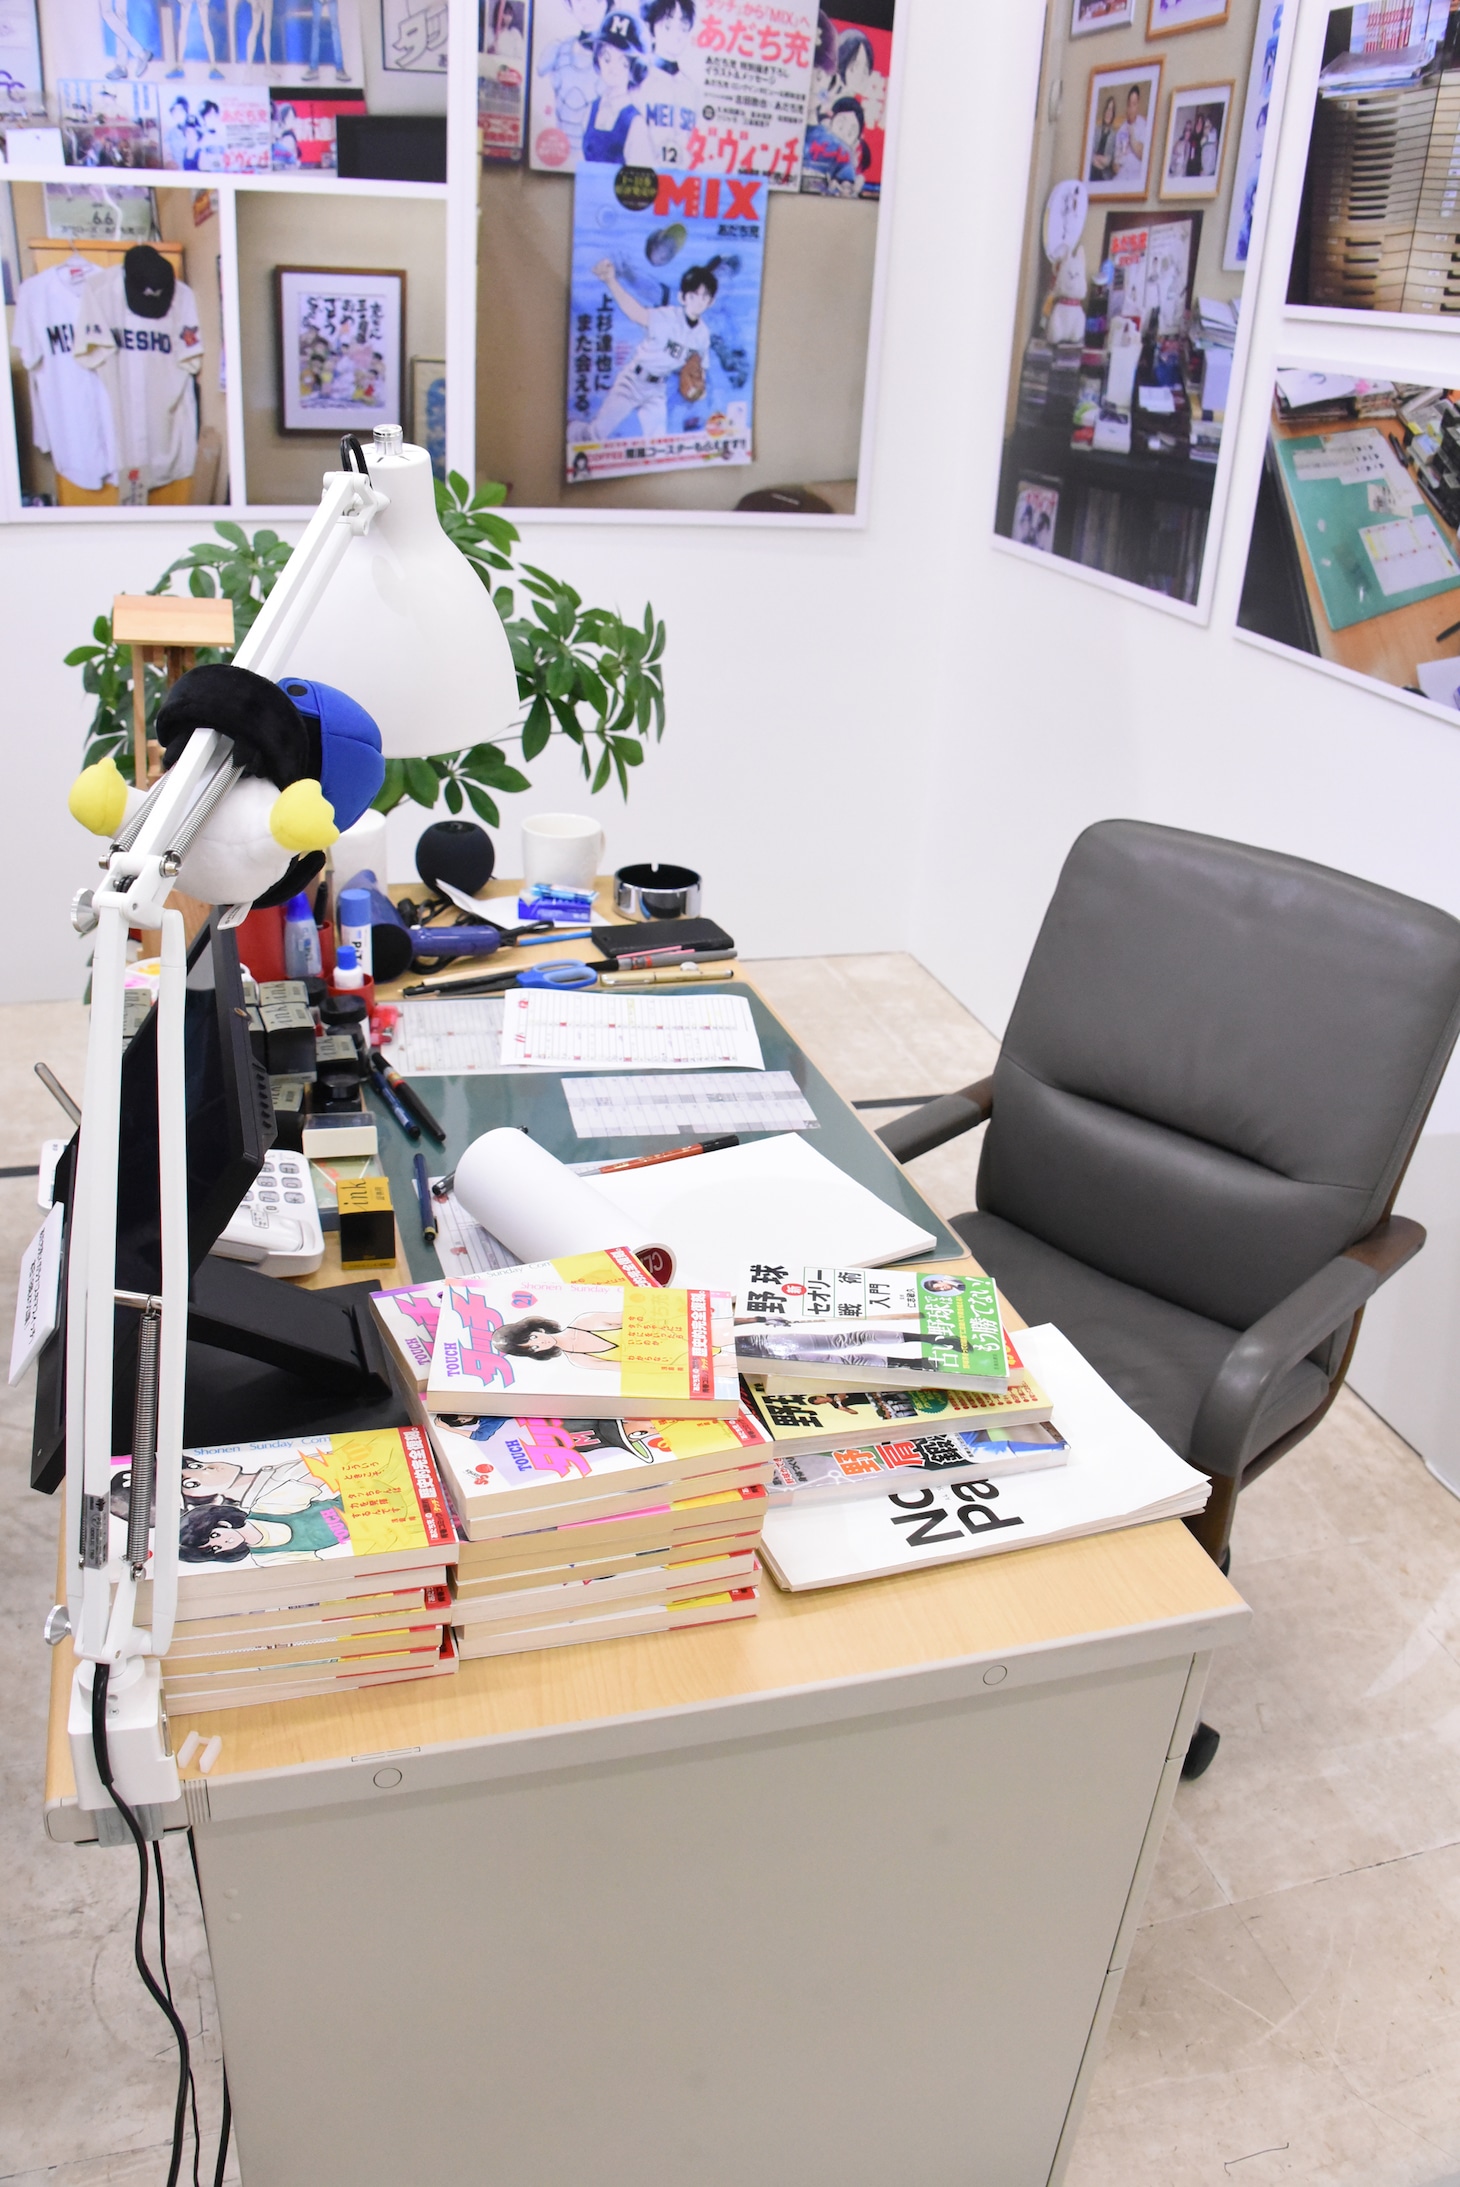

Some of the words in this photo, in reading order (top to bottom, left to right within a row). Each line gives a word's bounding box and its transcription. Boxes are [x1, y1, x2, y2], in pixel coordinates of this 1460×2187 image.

[697, 14, 811, 69] あだち充
[661, 146, 677, 163] 12
[653, 174, 762, 221] MIX
[266, 1004, 293, 1028] ink
[340, 1178, 369, 1211] ink
[512, 1293, 533, 1307] 21
[521, 1281, 563, 1291] Shonen
[570, 1284, 611, 1296] Sunday
[747, 1264, 789, 1314] 野球
[807, 1269, 831, 1315] セオリー
[869, 1283, 891, 1309] 入門
[690, 1289, 708, 1357] 歴史的完全復刻。
[965, 1276, 1001, 1353] もう勝てない!
[405, 1337, 431, 1366] TOUCH
[448, 1284, 516, 1389] タッチ
[444, 1342, 460, 1378] TOUCH
[193, 1445, 241, 1456] Shonen
[249, 1439, 293, 1450] Sunday
[403, 1427, 438, 1499] 歴史的完全復刻。
[505, 1438, 533, 1473] TOUCH
[514, 1418, 592, 1478] タッ
[876, 1440, 926, 1470] 肩
[914, 1432, 964, 1465] 鍛
[342, 1461, 379, 1471] こういう
[348, 1487, 402, 1499] タッちゃんは
